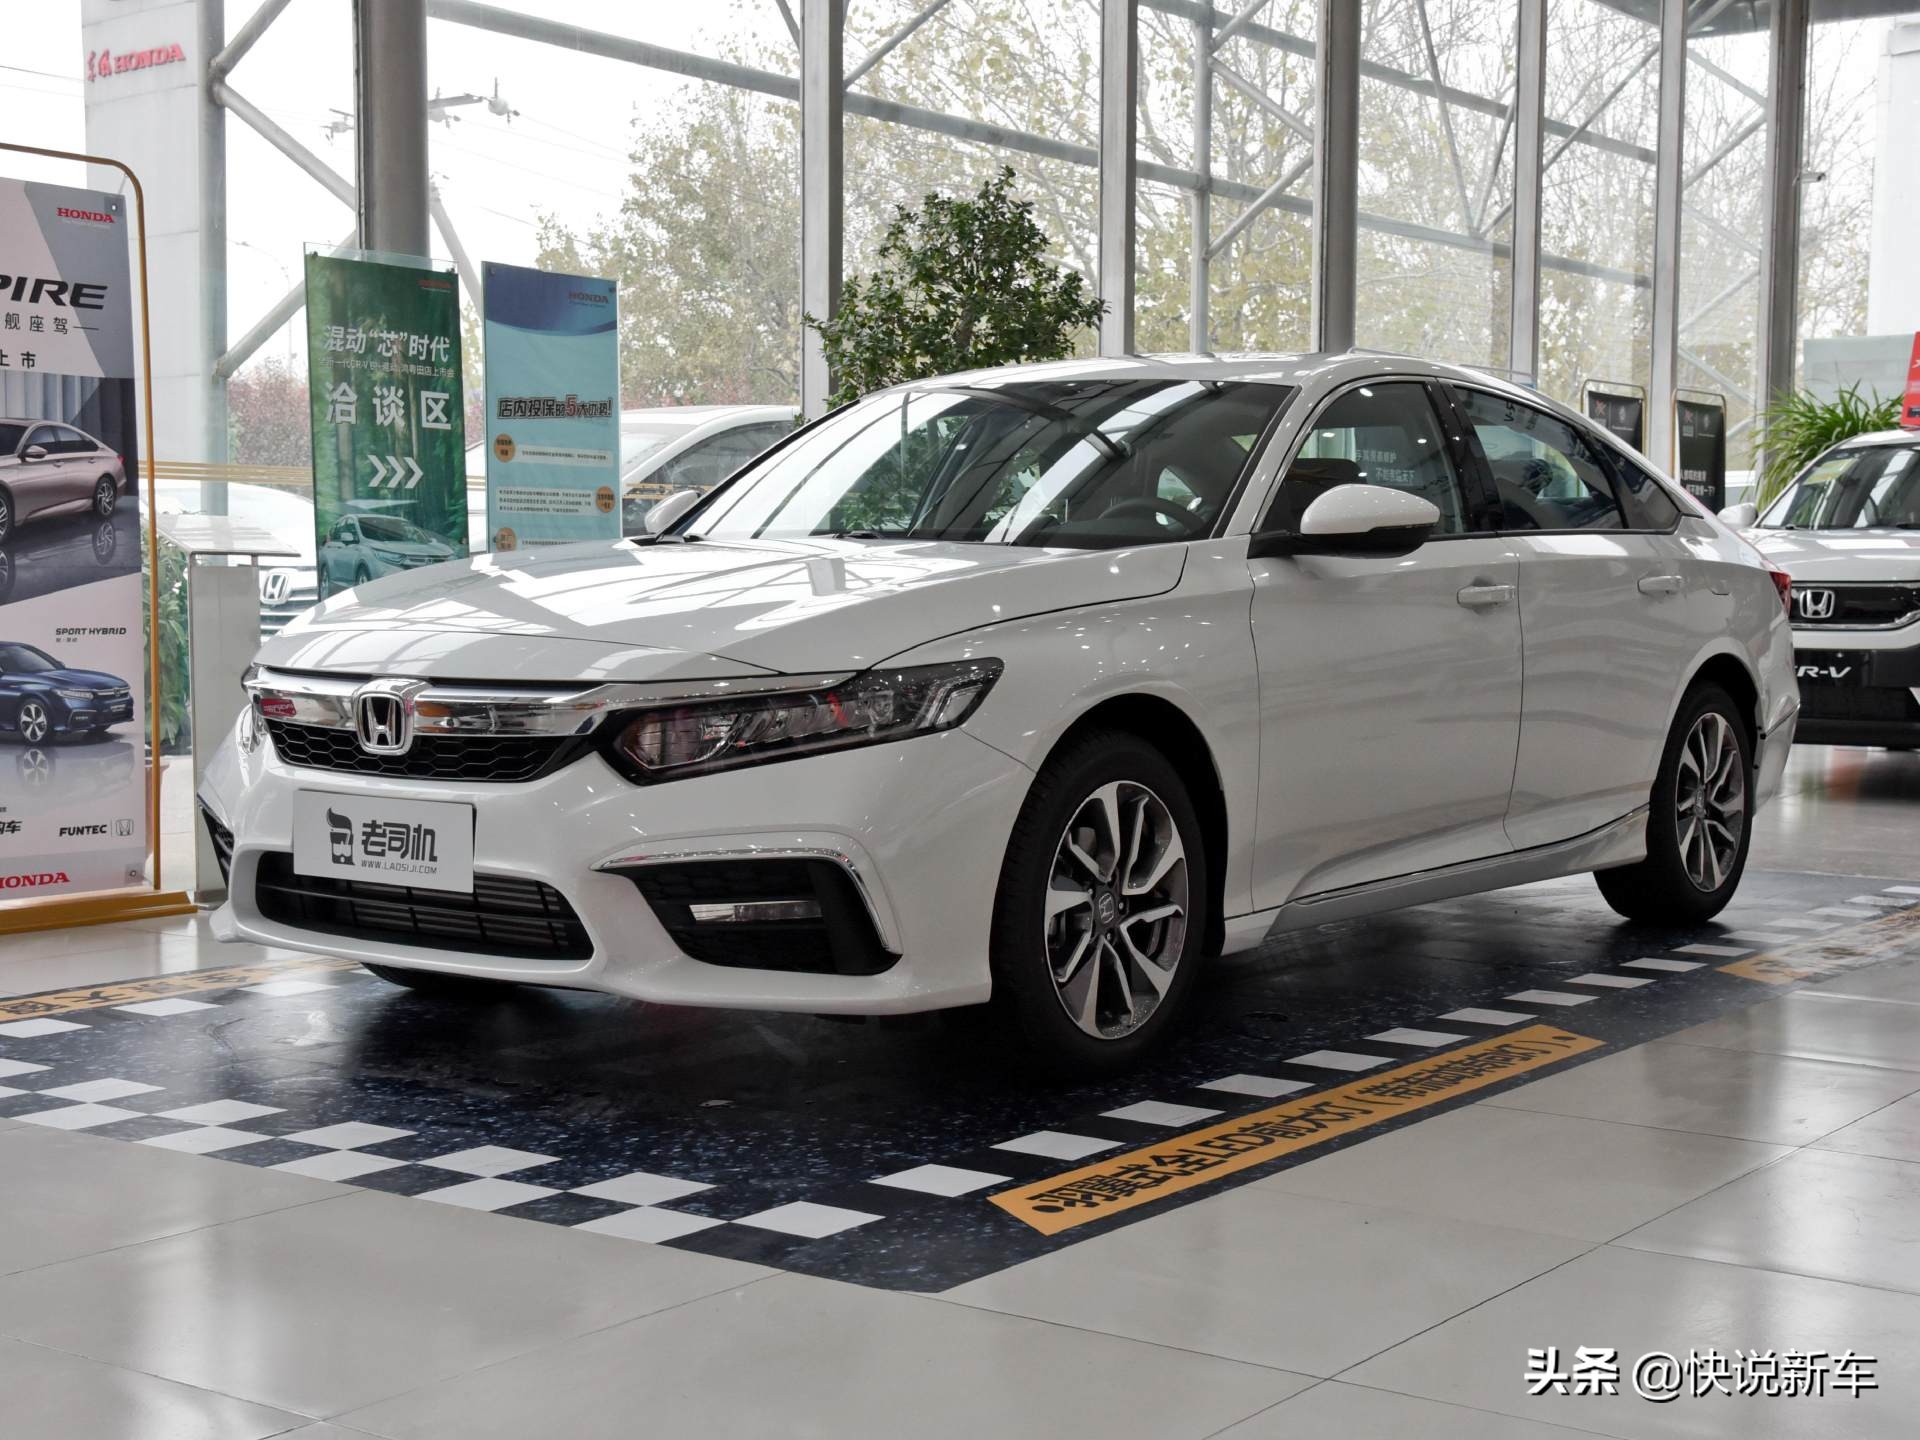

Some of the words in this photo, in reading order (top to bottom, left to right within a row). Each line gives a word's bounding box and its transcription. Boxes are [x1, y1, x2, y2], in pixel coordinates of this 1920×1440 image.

[57, 207, 116, 223] HONDA
[568, 291, 609, 304] HONDA
[4, 312, 69, 335] 舰座驾
[324, 325, 450, 363] 混动“芯”时代
[326, 381, 452, 430] 洽谈区
[55, 627, 87, 636] SPORT
[88, 627, 127, 636] HYBRID
[1794, 665, 1852, 678] R-V
[59, 824, 108, 837] FUNTEC
[361, 819, 438, 862] 老司机
[361, 859, 437, 875] WWW.LAOSIJI.COM
